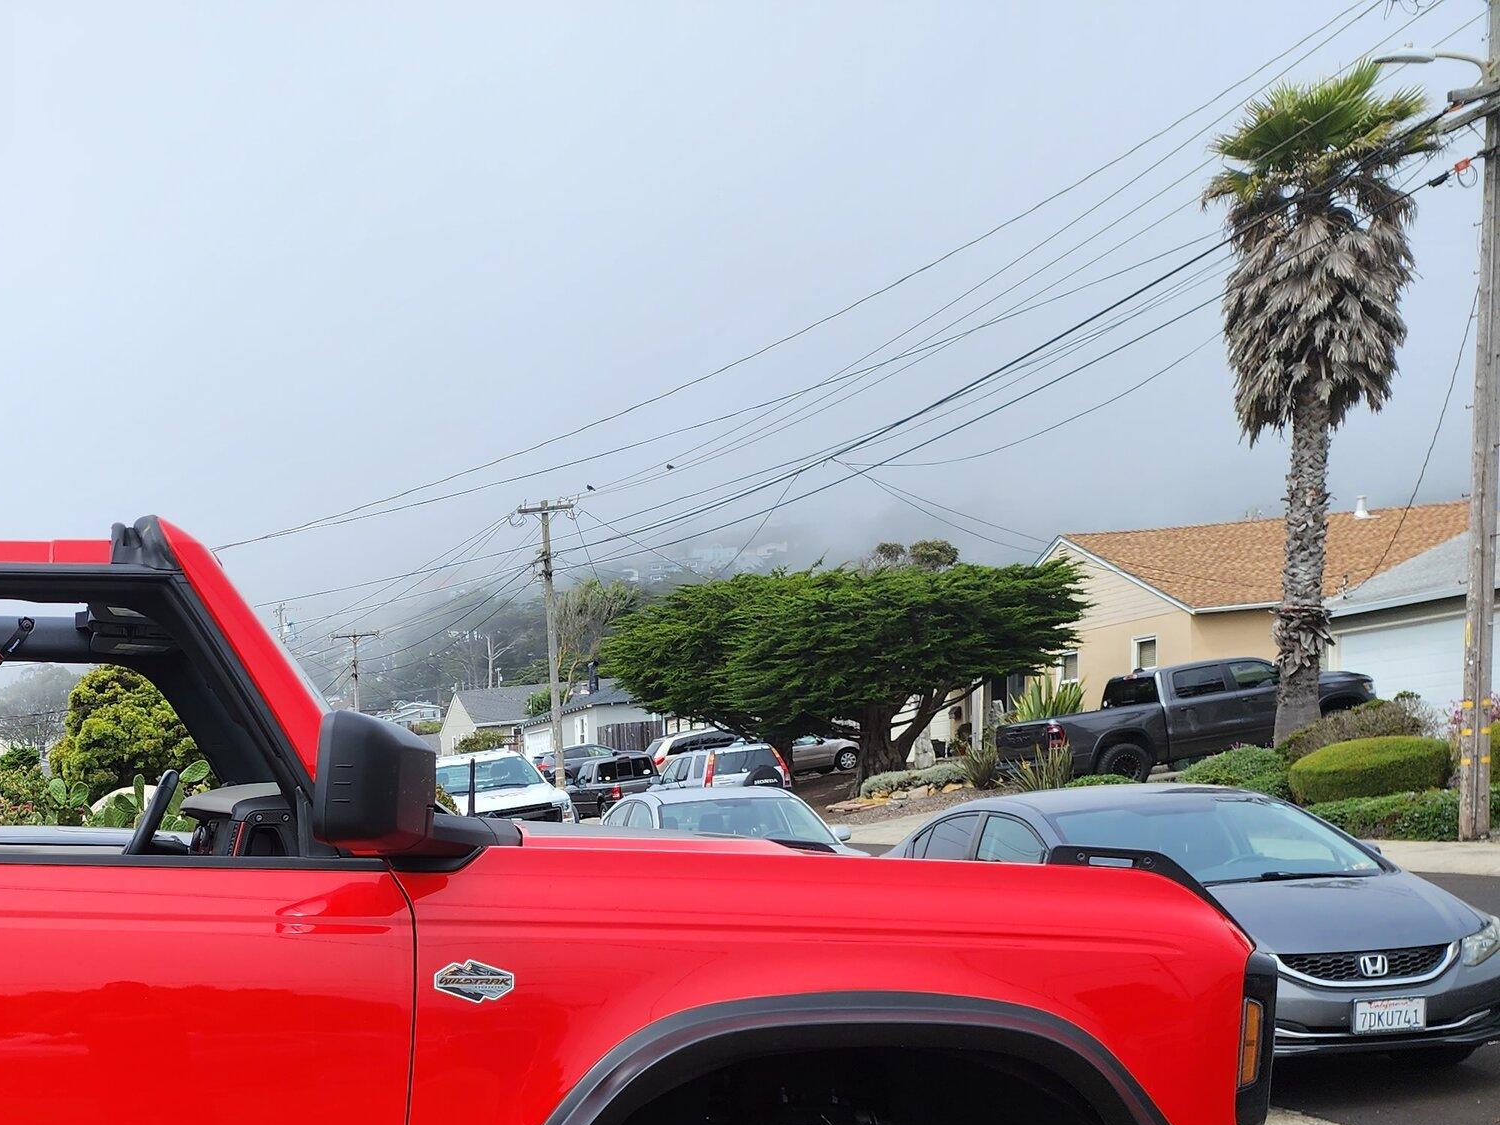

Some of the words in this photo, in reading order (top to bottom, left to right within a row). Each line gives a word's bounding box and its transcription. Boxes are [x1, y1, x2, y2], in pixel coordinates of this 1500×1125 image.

[439, 977, 511, 986] WILDTRAK
[1368, 1001, 1409, 1009] California
[1360, 1009, 1421, 1029] 7DKU741
